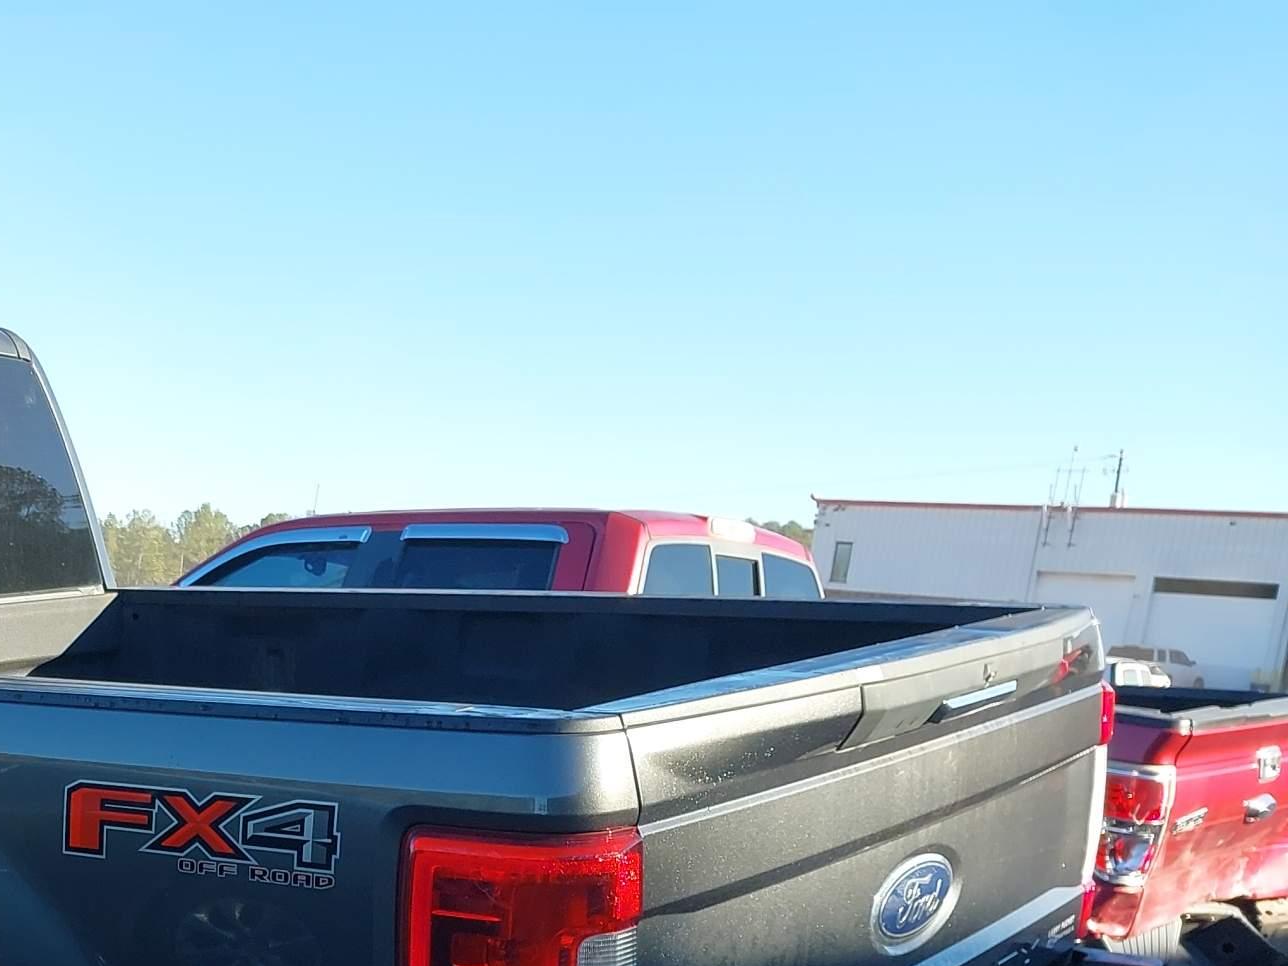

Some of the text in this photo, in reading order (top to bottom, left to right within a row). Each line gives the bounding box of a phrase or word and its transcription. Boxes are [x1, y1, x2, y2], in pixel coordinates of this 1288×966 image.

[63, 779, 341, 874] FX4
[177, 857, 335, 890] OFF ROAD
[896, 873, 943, 929] Ford
